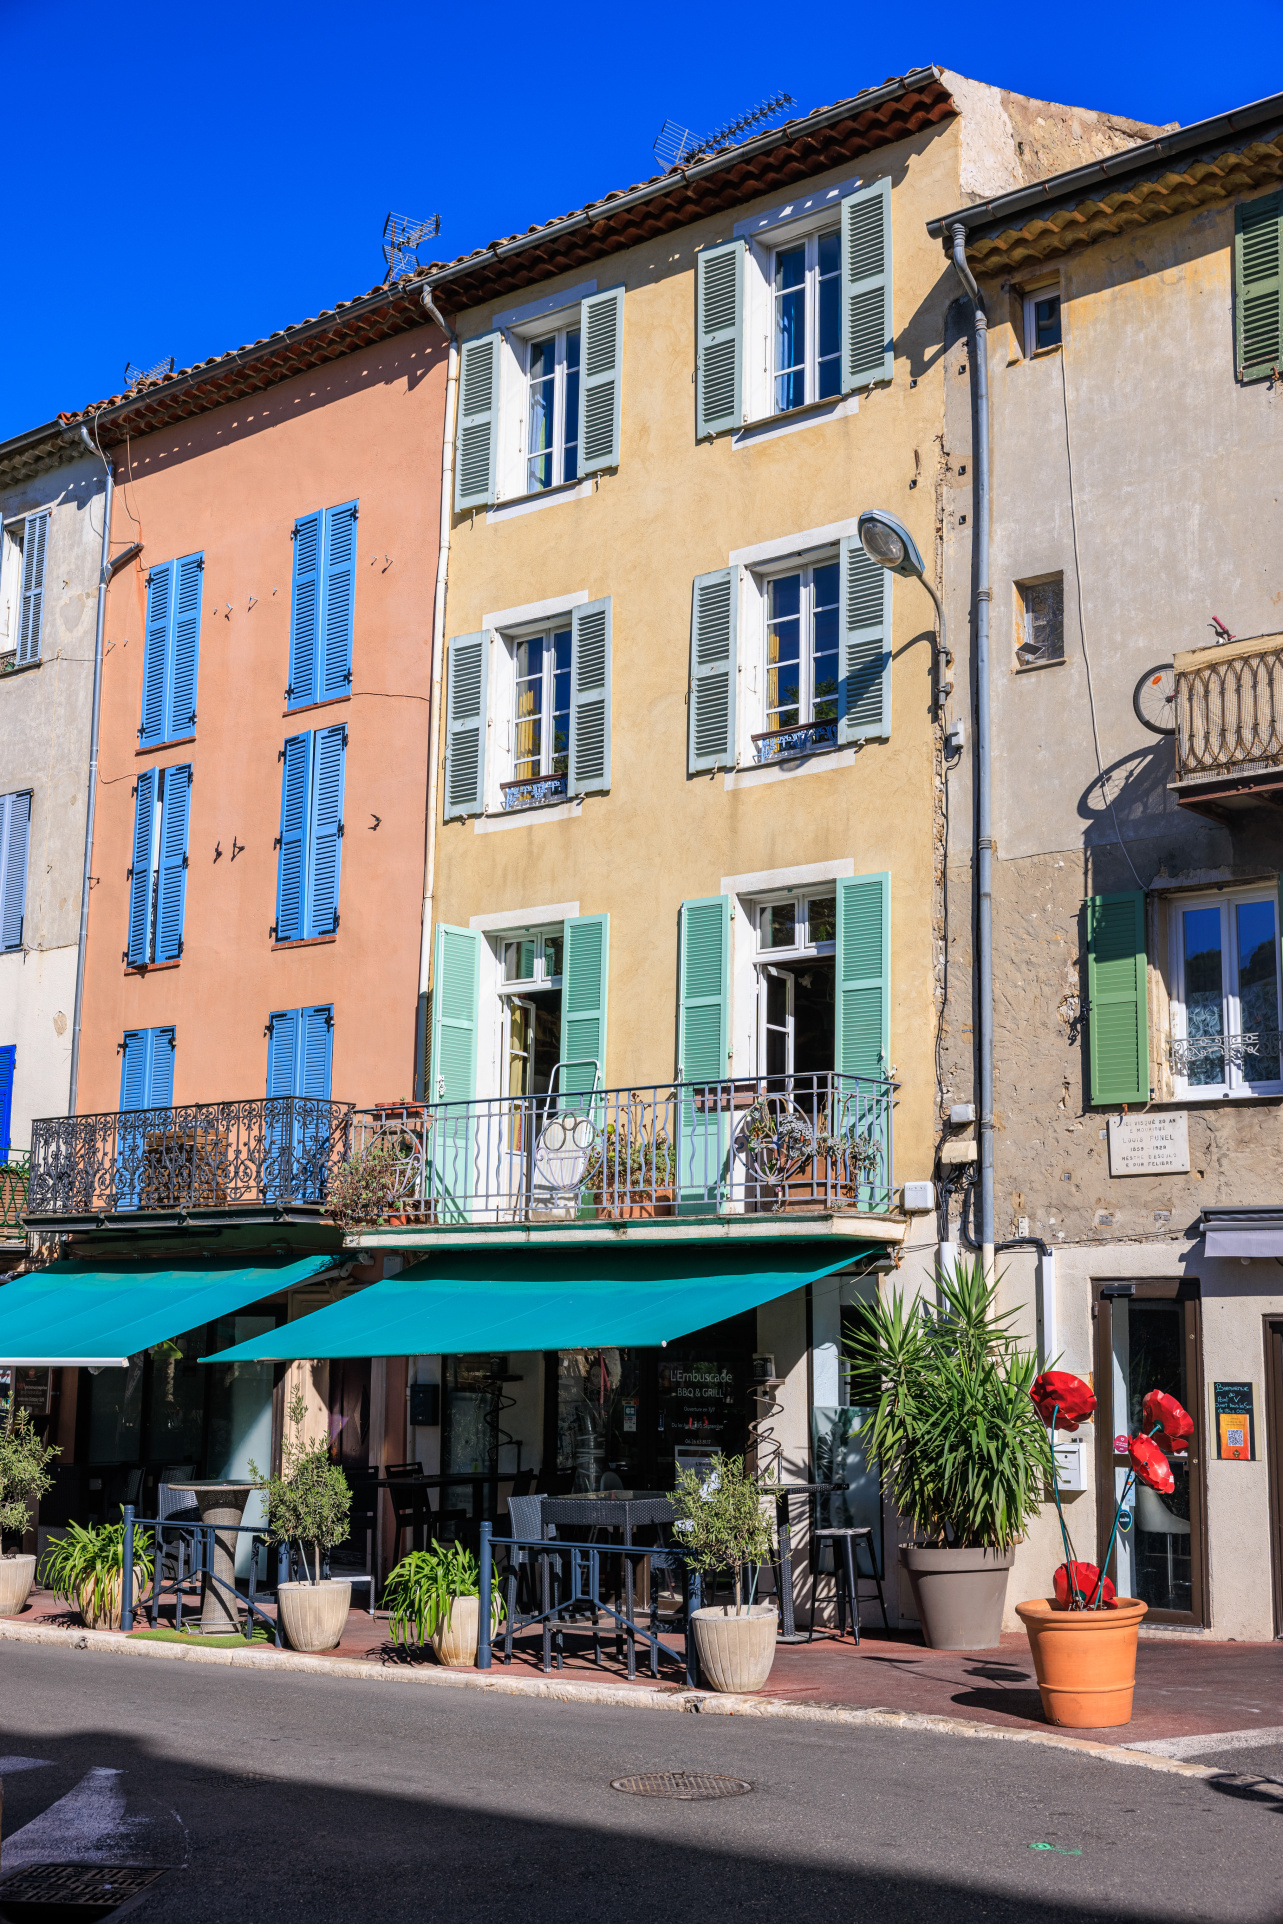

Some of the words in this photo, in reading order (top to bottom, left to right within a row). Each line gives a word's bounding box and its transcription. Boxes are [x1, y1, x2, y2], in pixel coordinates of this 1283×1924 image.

[1149, 1134, 1174, 1142] FUNEL
[670, 1369, 733, 1383] L'Embuscade
[677, 1387, 694, 1398] BBQ
[695, 1388, 701, 1397] &
[702, 1388, 724, 1398] GRILL
